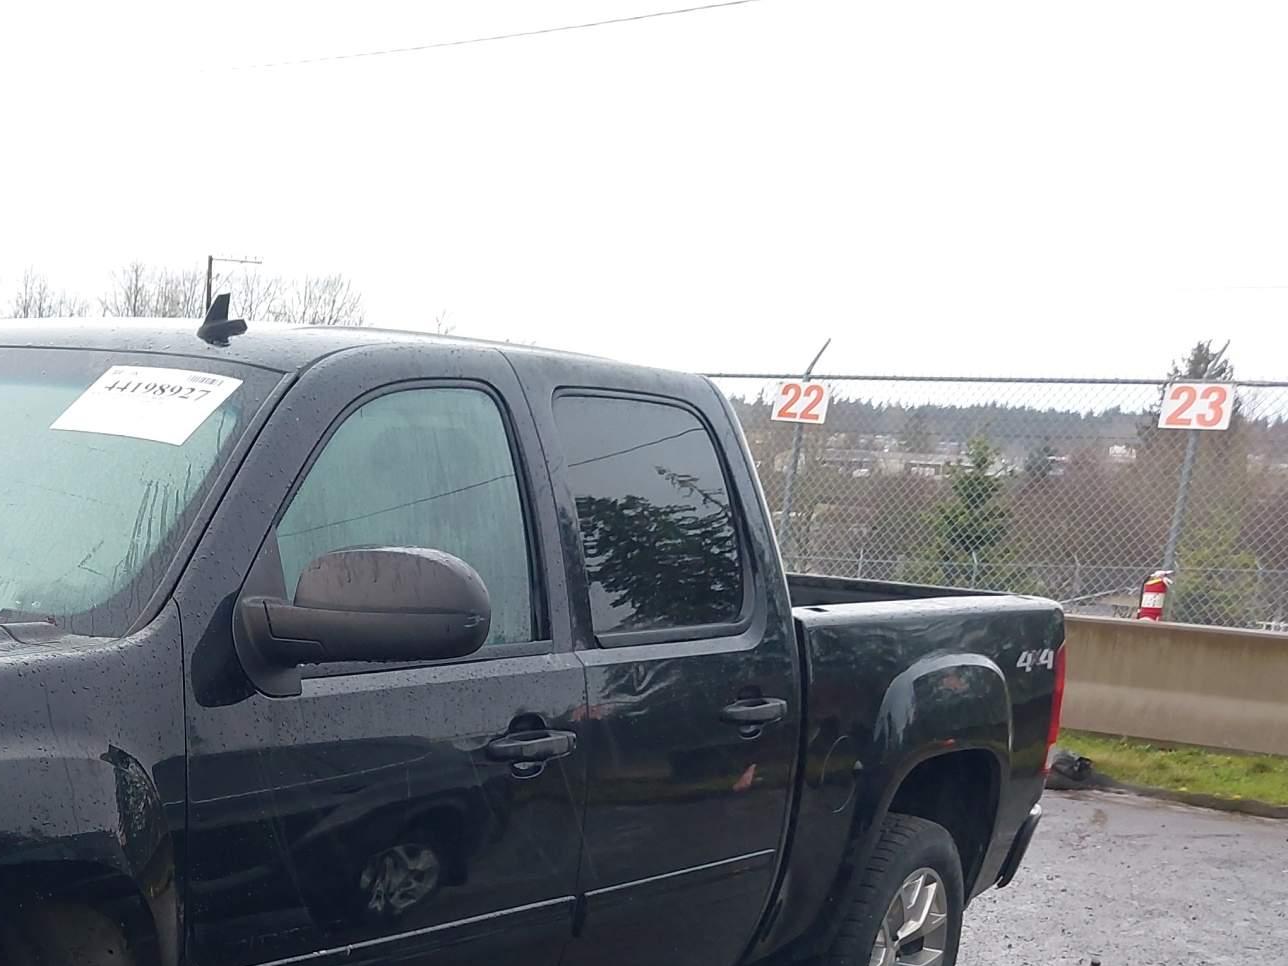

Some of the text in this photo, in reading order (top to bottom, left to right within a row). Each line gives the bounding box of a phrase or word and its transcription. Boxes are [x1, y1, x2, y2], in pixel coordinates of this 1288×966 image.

[104, 379, 212, 402] 44198927
[776, 383, 826, 421] 22
[1164, 385, 1228, 427] 23
